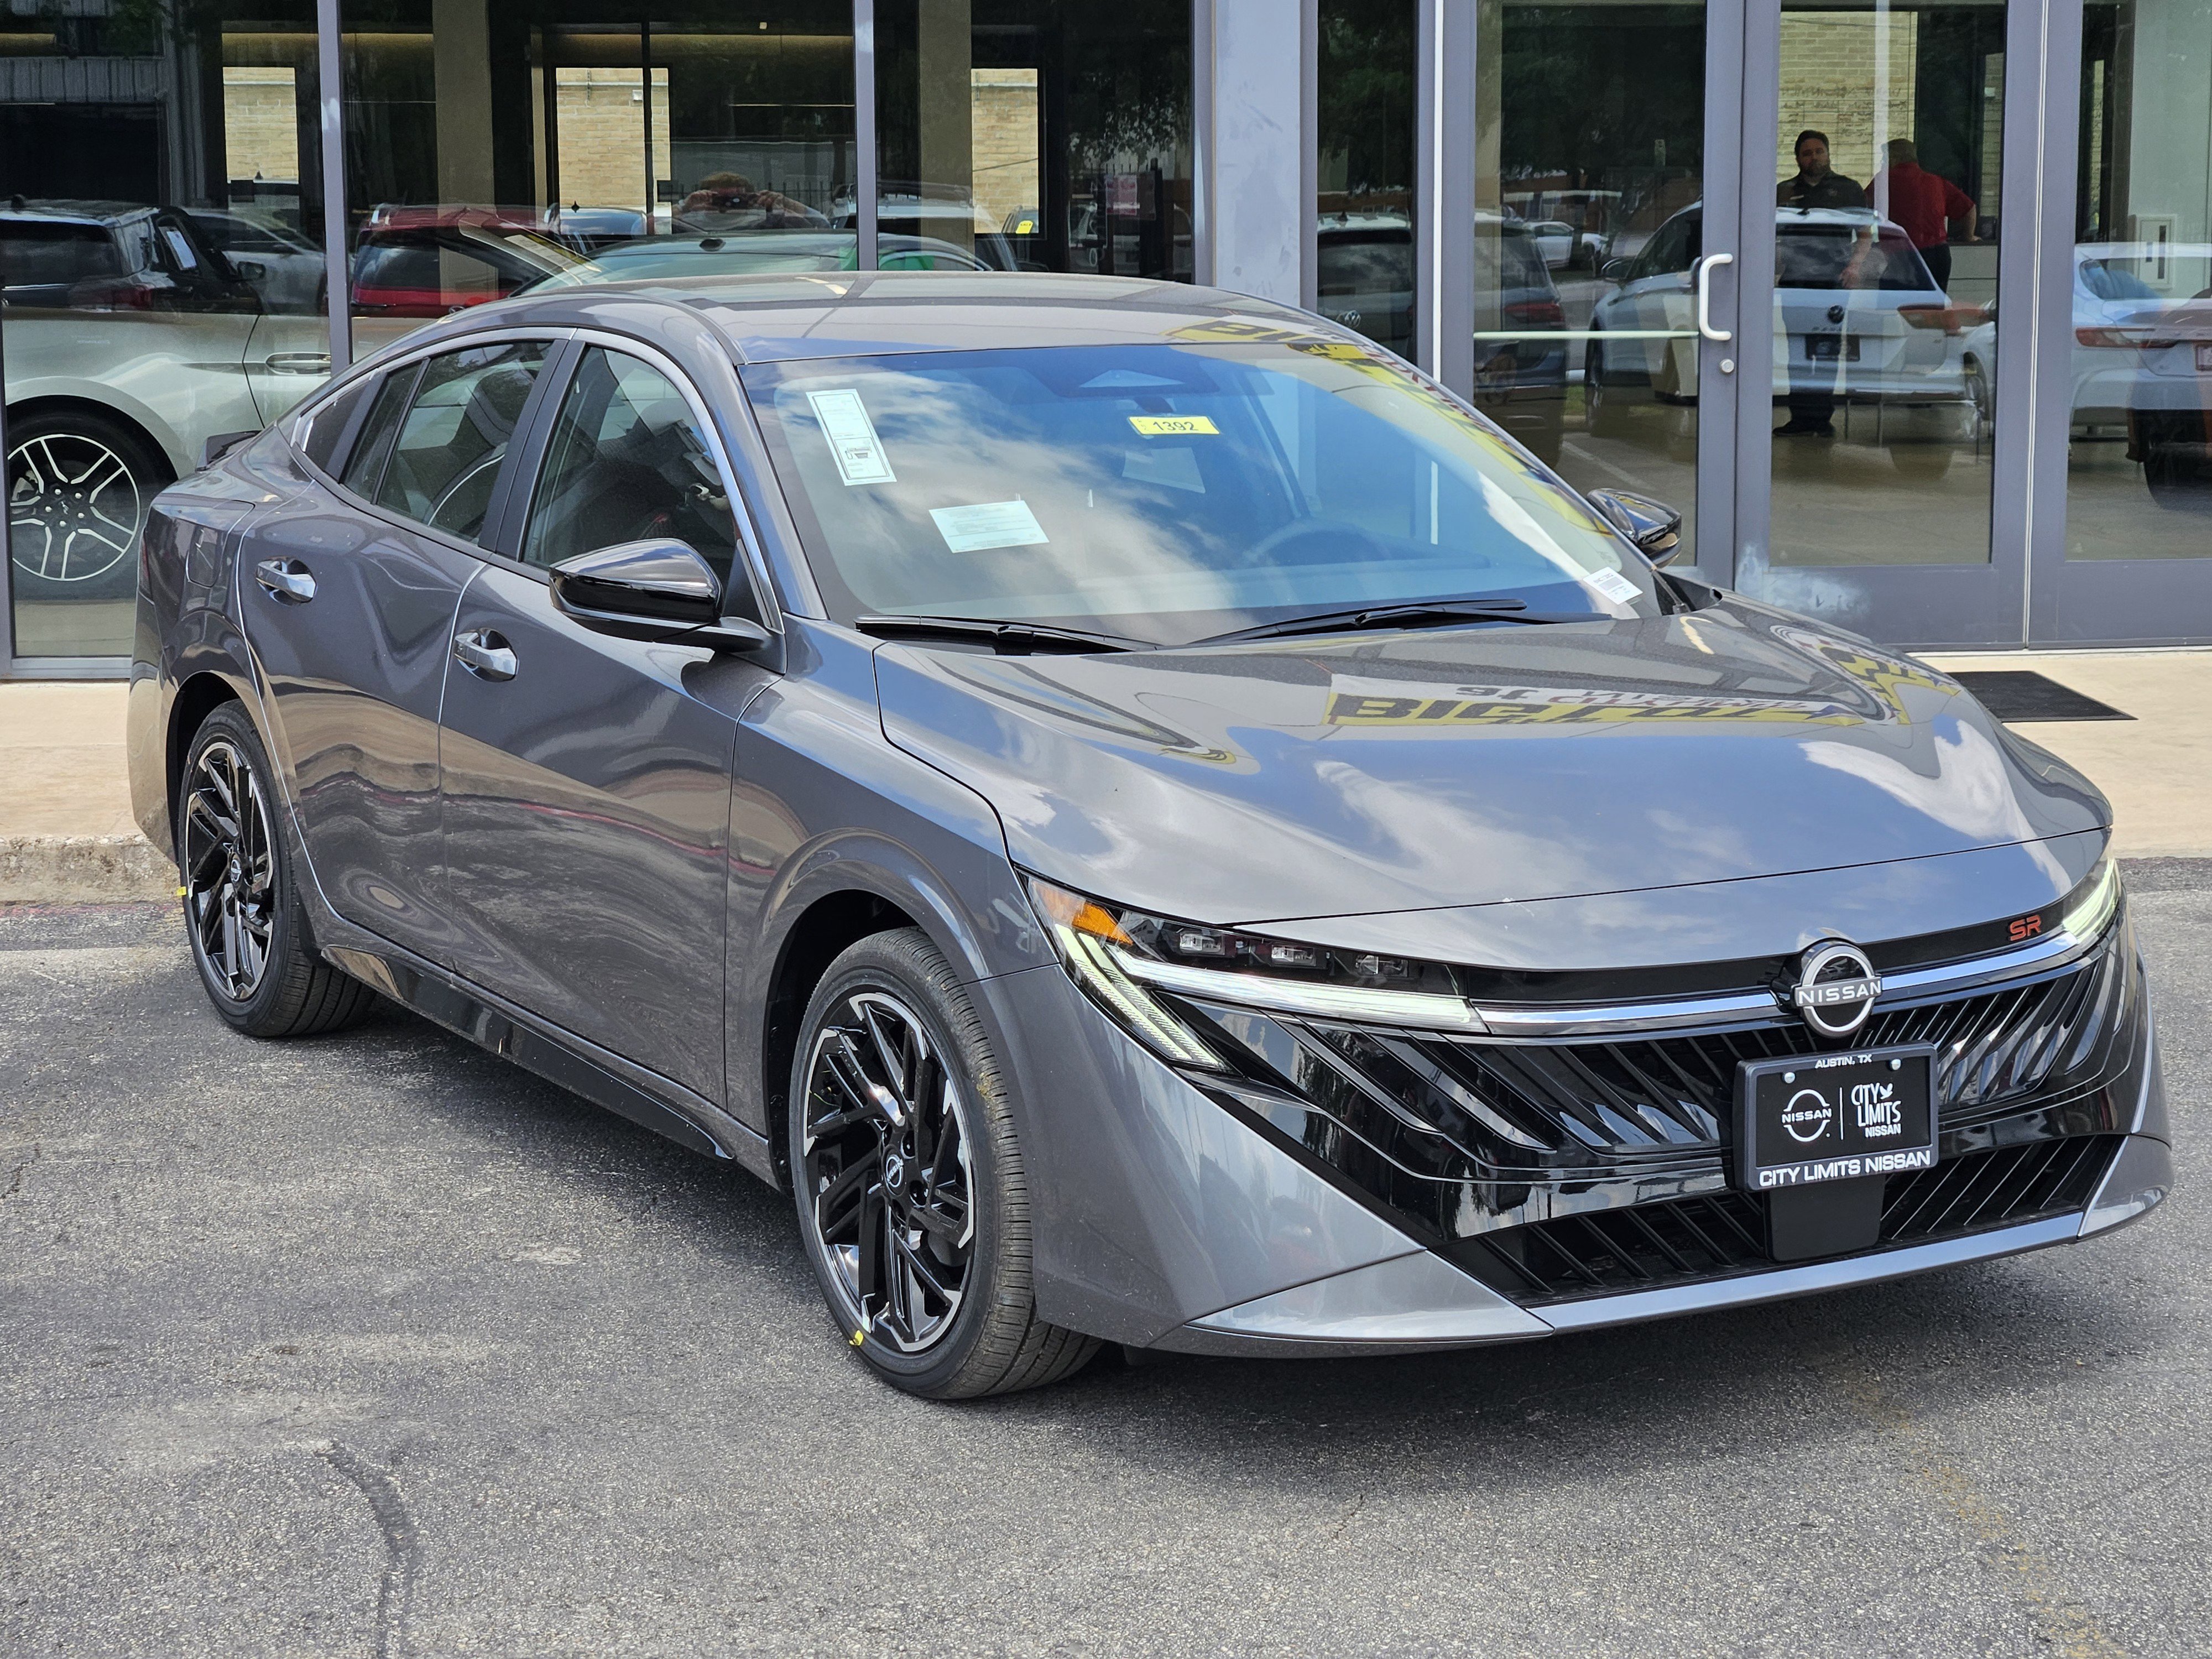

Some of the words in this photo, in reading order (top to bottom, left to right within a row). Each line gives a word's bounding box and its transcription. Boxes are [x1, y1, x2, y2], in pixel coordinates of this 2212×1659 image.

[1153, 421, 1198, 431] 1392
[2010, 915, 2042, 941] SR
[1798, 980, 1882, 1004] NISSAN
[1814, 1056, 1855, 1068] AUSTIN,
[1858, 1054, 1872, 1063] TX
[1851, 1082, 1880, 1105] CITY
[1782, 1108, 1832, 1123] NISSAN
[1857, 1100, 1901, 1127] LIMITS
[1865, 1123, 1901, 1138] NISSAN
[1759, 1166, 1801, 1187] CITY
[1803, 1160, 1861, 1181] LIMITS
[1865, 1150, 1931, 1173] NISSAN
